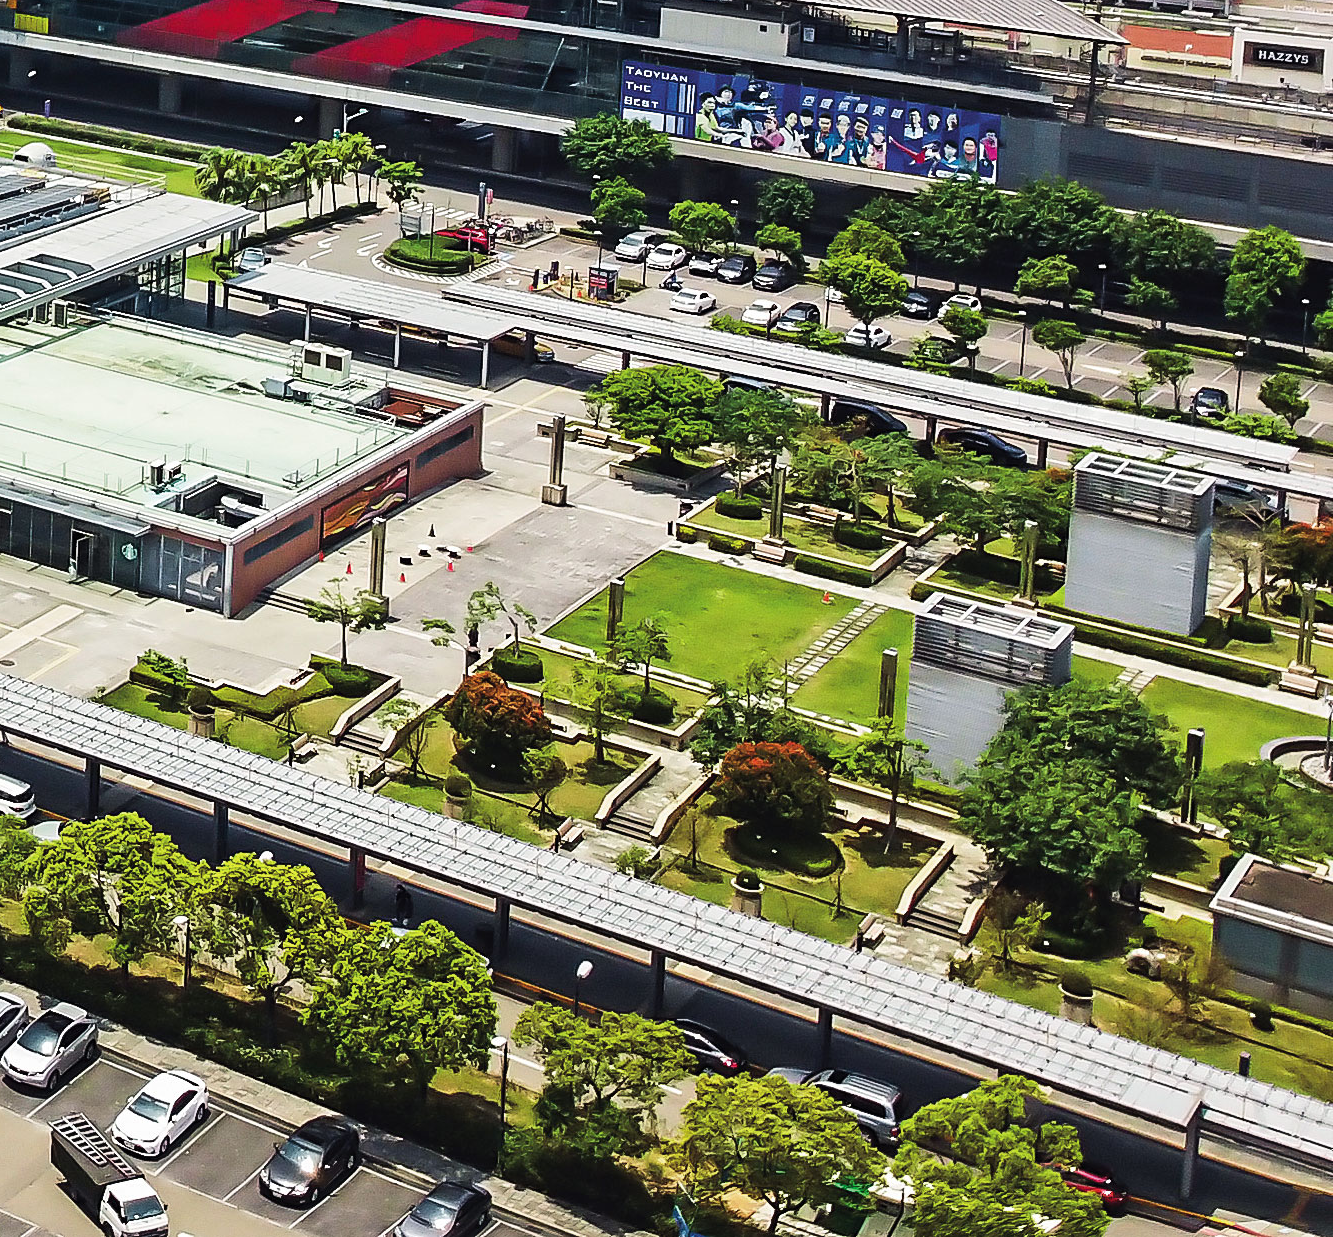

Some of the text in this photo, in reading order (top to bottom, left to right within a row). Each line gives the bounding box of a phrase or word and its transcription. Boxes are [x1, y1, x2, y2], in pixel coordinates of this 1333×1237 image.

[1258, 49, 1309, 65] HAZZYS
[625, 65, 688, 83] TAOYUAN
[625, 81, 652, 93] THE
[624, 96, 659, 109] BEST
